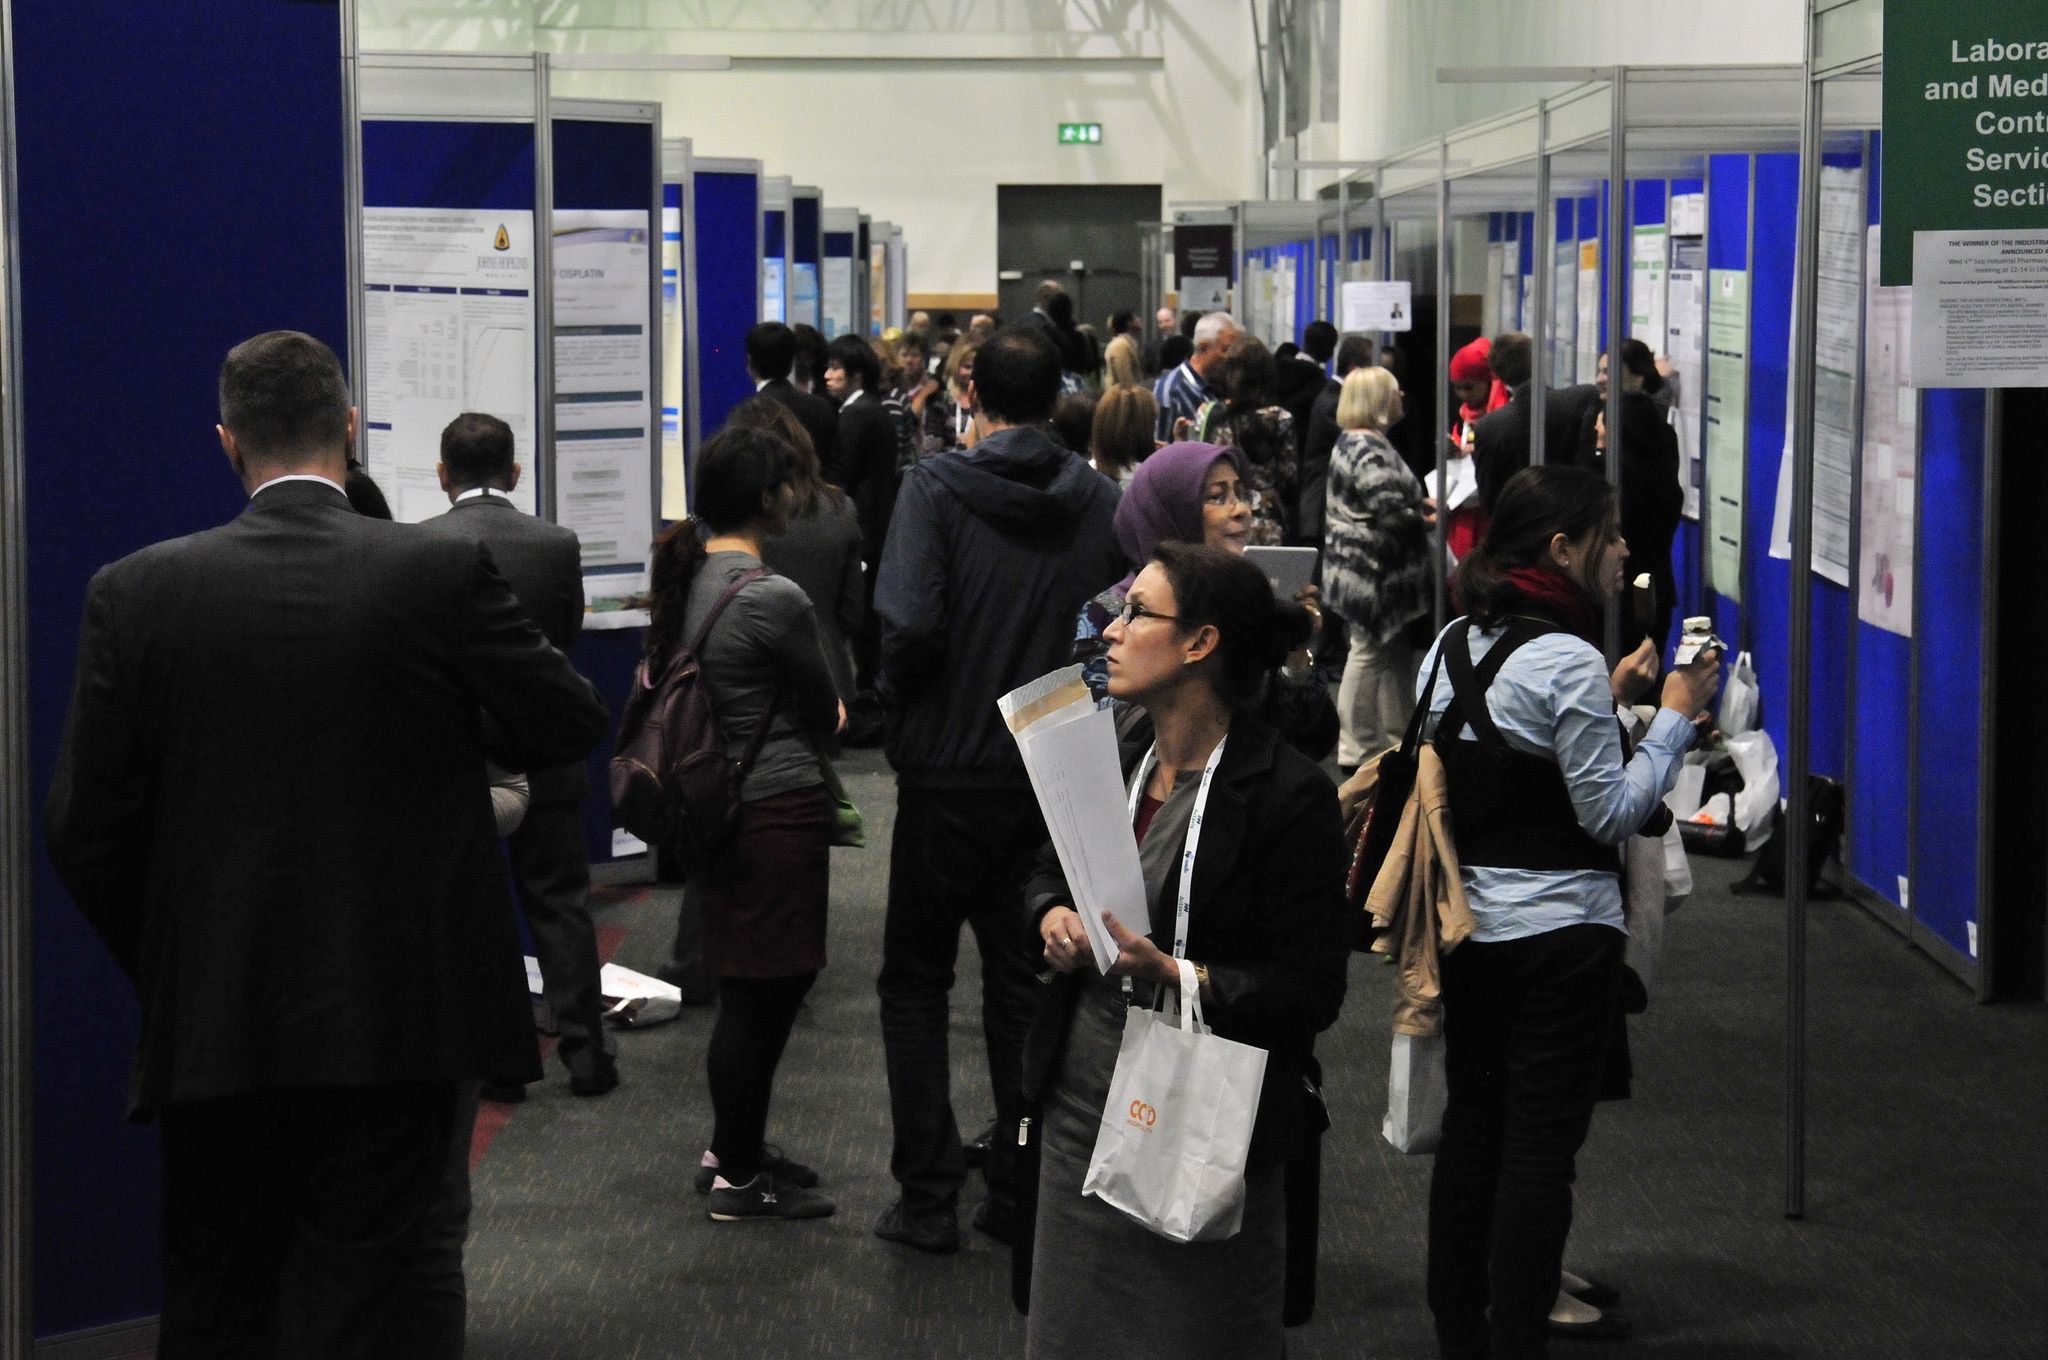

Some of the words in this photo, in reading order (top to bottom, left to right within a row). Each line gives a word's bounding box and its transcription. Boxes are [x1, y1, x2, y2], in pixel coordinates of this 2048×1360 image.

[1952, 38, 2048, 63] Labora
[1924, 75, 1978, 101] and
[1988, 73, 2048, 98] Med
[1975, 110, 2048, 135] Cont
[1973, 182, 2048, 208] Secti
[560, 268, 605, 279] CISPLATIN
[1987, 257, 2015, 265] Industrial
